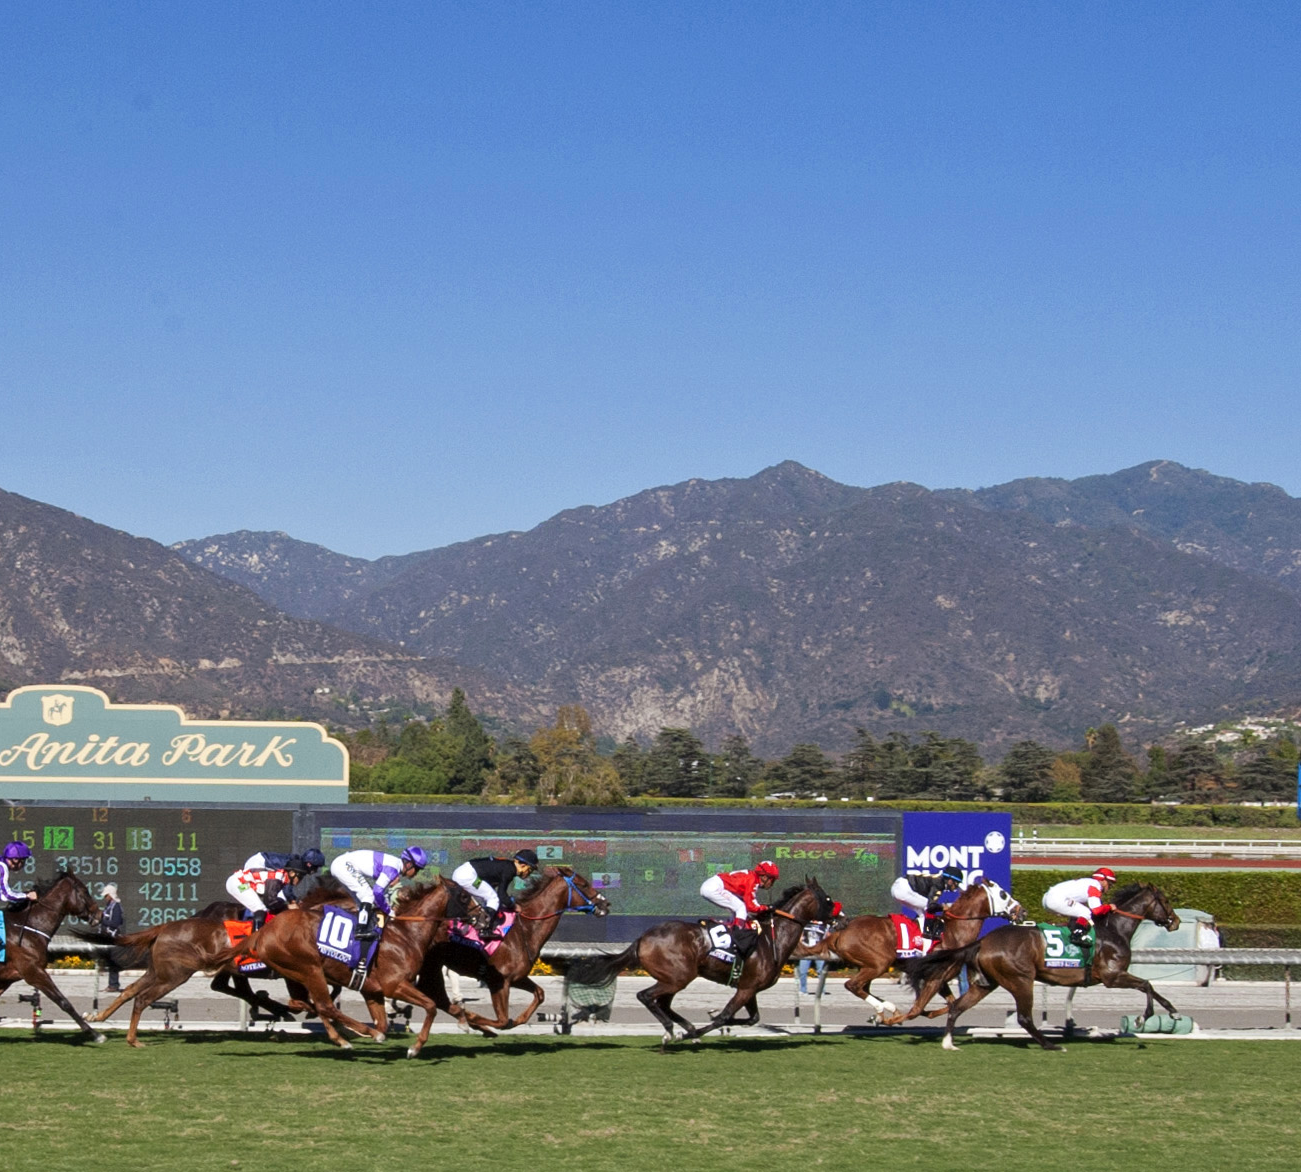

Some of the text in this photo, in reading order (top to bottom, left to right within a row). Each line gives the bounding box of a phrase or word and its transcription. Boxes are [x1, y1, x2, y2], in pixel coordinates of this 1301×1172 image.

[162, 733, 297, 769] Park
[9, 806, 27, 822] 12
[91, 808, 109, 823] 12
[12, 829, 36, 849] 15
[48, 828, 70, 849] 12
[92, 831, 116, 850] 31
[130, 829, 153, 851] 13
[176, 832, 199, 852] 11
[545, 847, 555, 858] 2
[775, 847, 838, 860] Race
[906, 845, 985, 868] MONT
[55, 856, 119, 875] 33516
[138, 857, 202, 877] 90558
[138, 883, 200, 902] 42111
[318, 911, 354, 949] 10
[709, 924, 732, 949] 6
[900, 923, 910, 949] 1
[1043, 929, 1064, 957] 5
